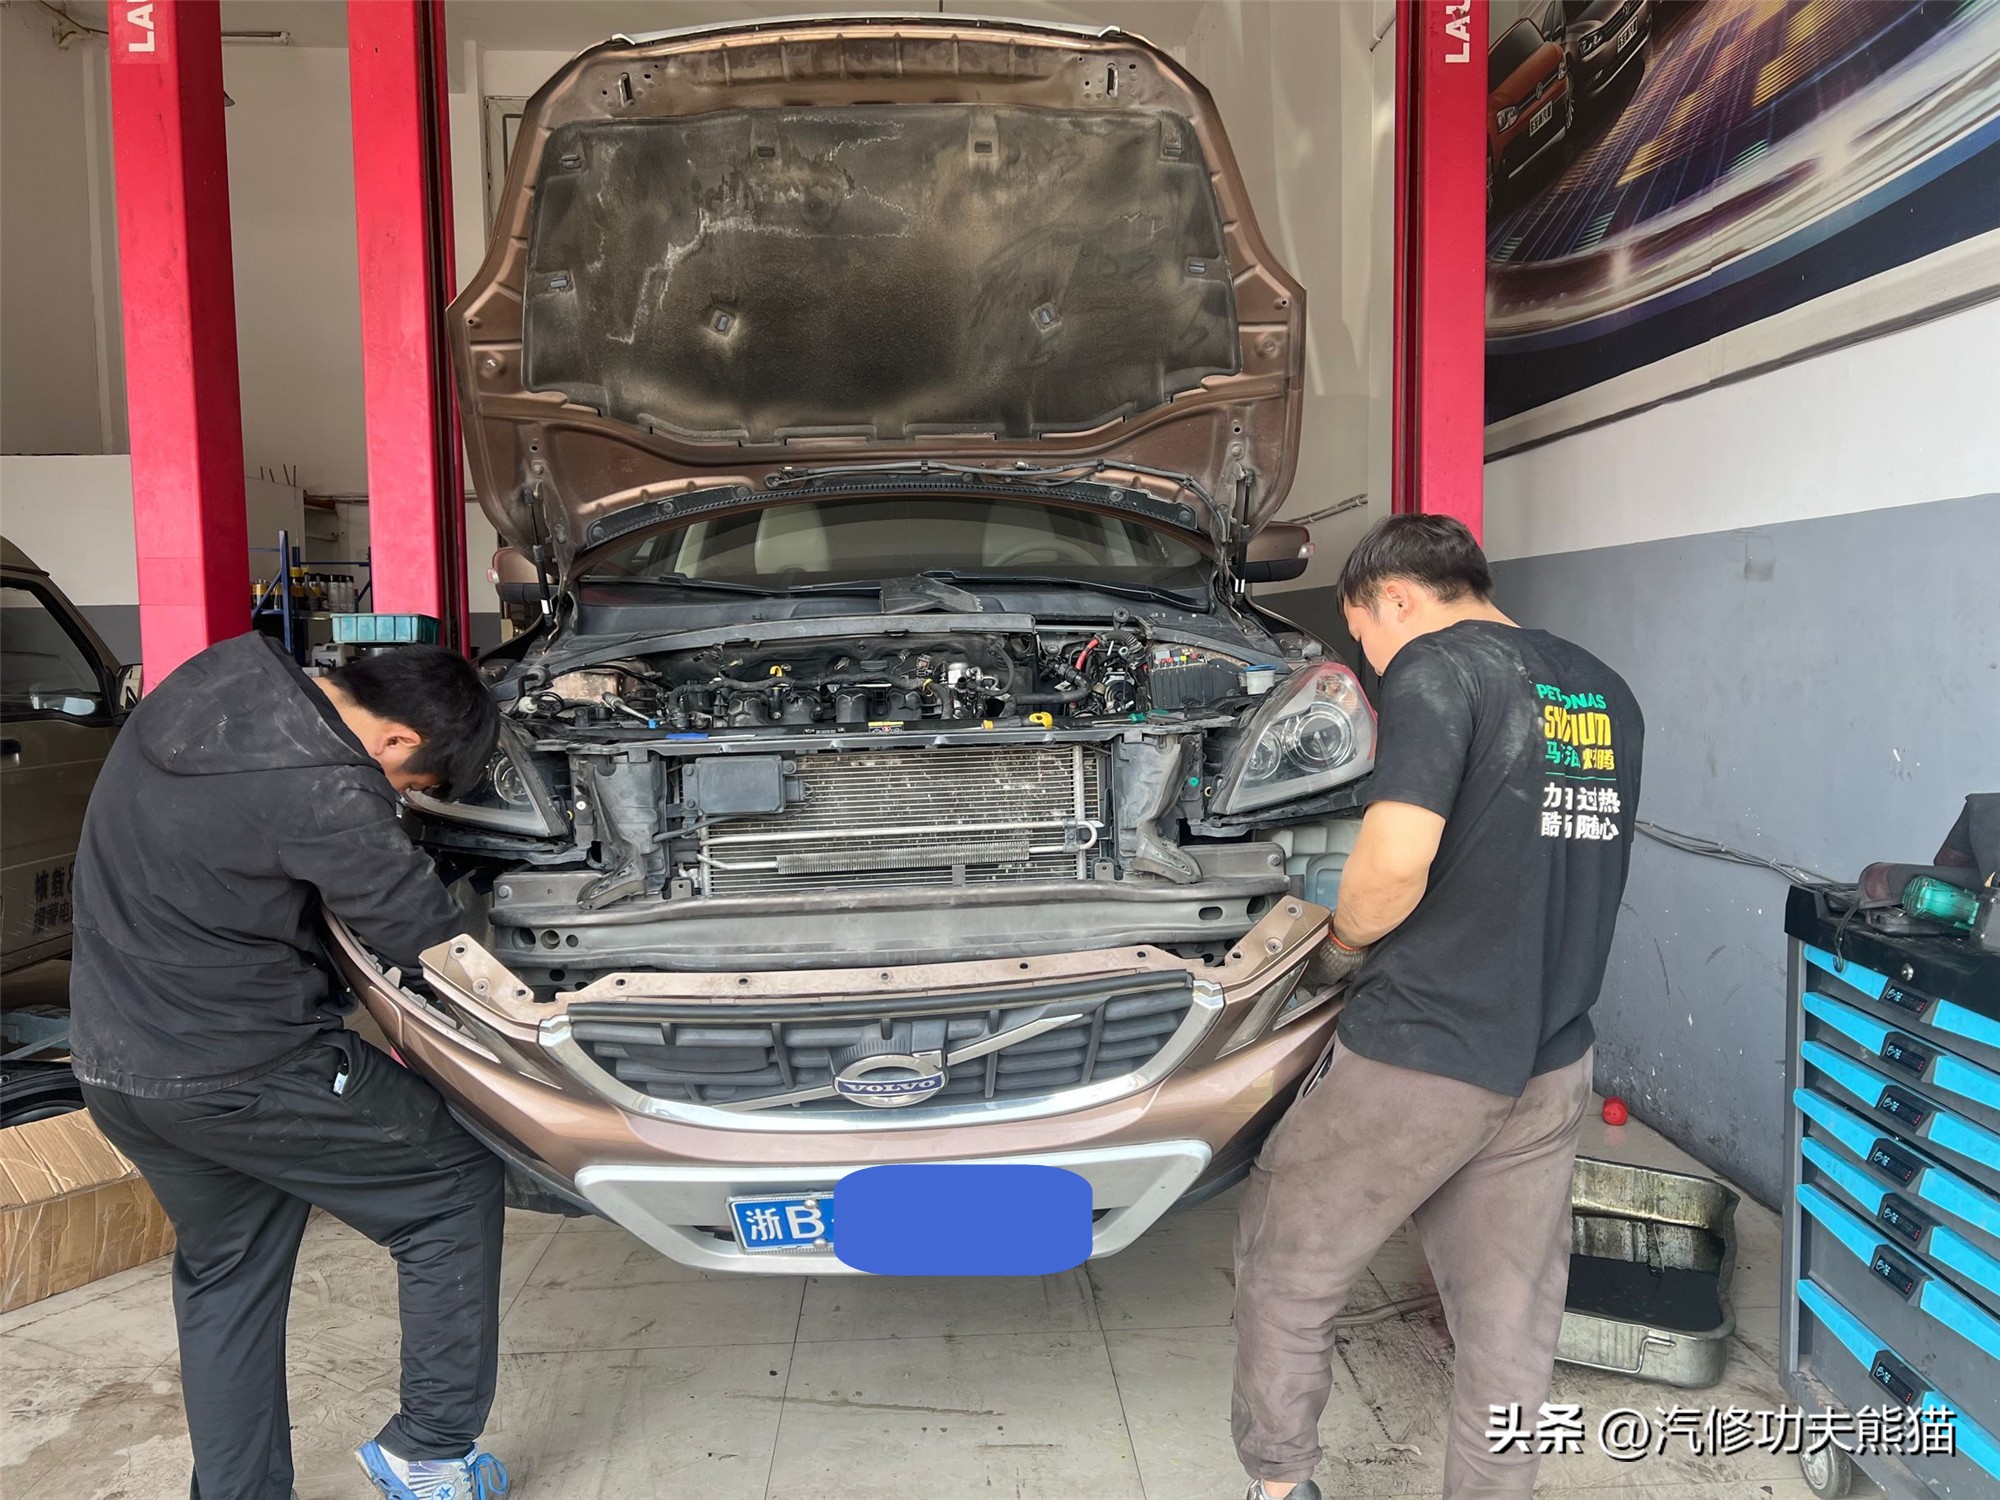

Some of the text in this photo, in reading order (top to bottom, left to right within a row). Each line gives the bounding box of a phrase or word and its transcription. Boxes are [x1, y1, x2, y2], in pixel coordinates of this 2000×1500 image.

[127, 0, 155, 52] LA
[1536, 683, 1607, 710] PETONAS
[843, 1080, 936, 1093] VOLVO
